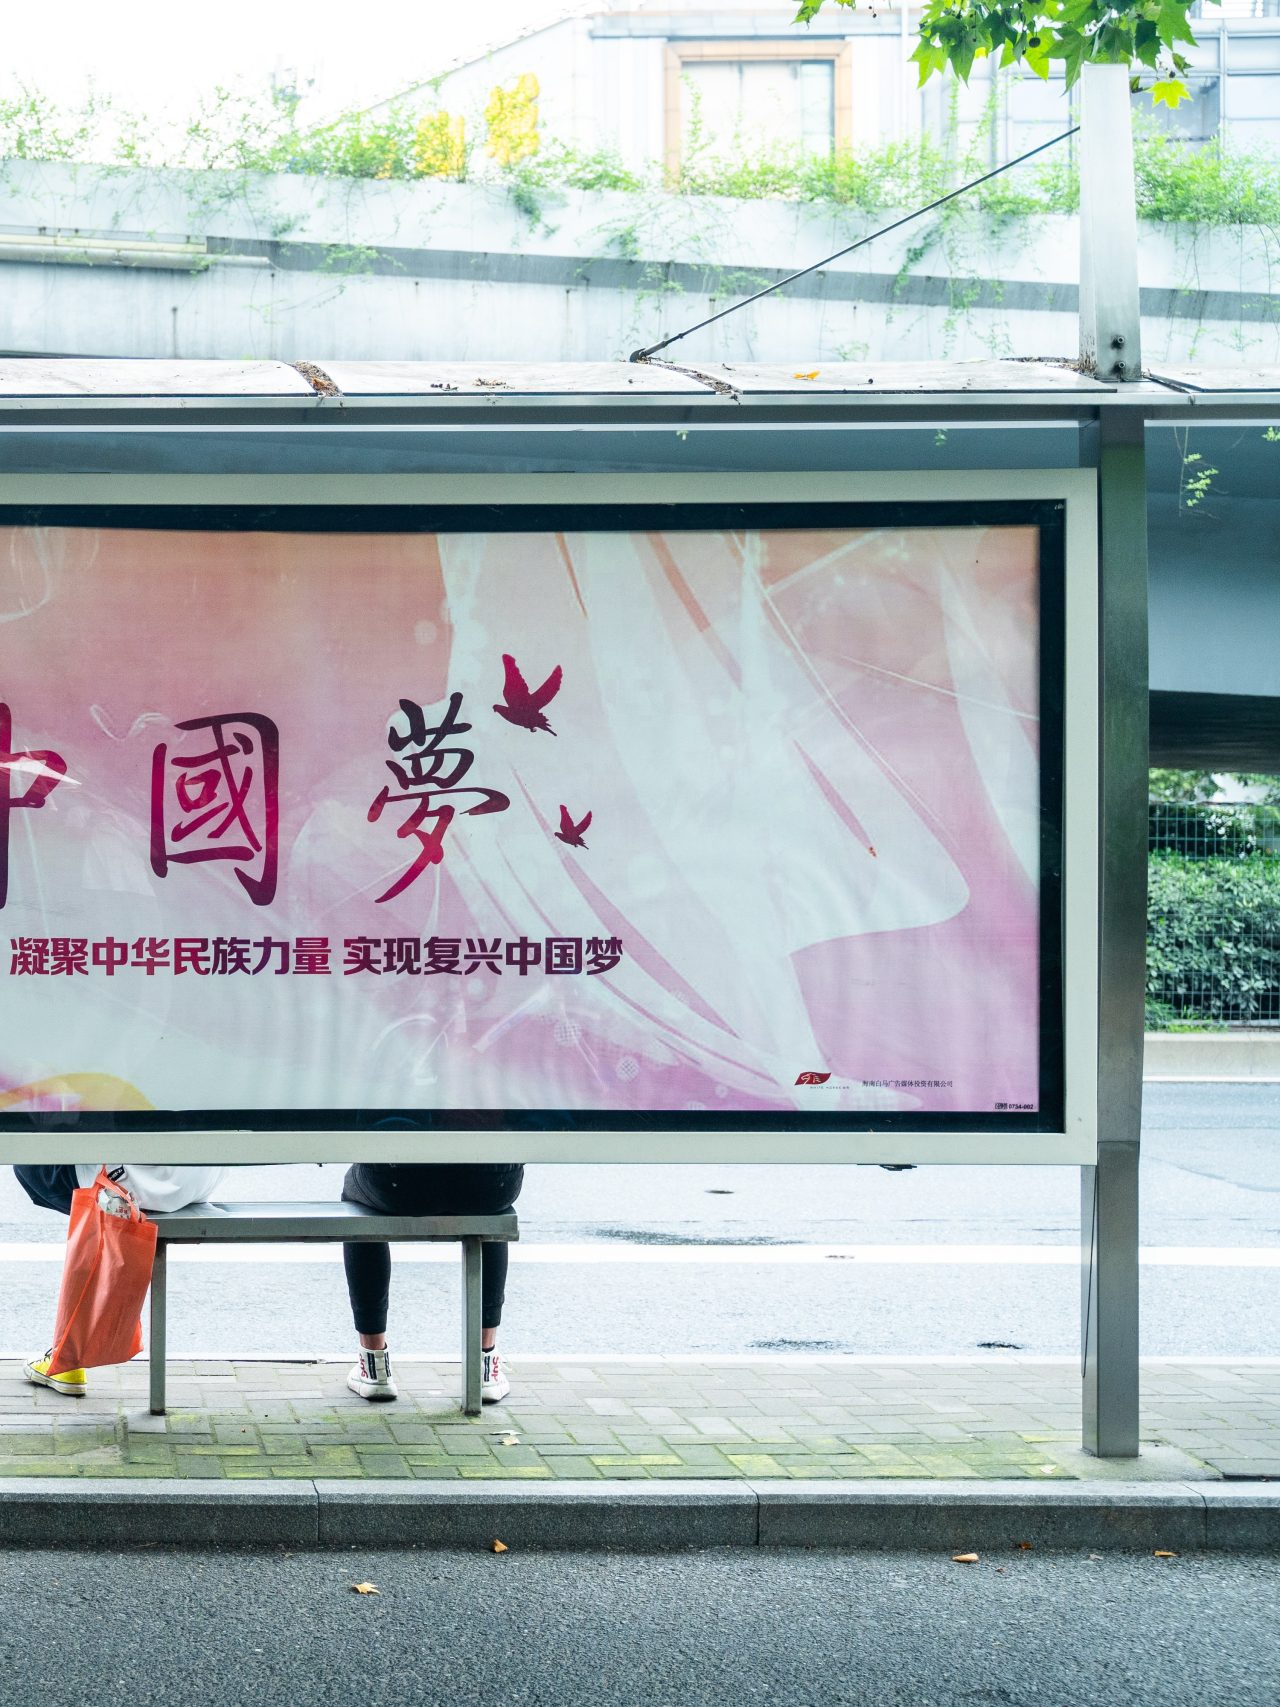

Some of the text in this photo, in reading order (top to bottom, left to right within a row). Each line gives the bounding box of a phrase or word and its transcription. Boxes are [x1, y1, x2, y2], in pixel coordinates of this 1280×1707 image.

[9, 936, 624, 977] 凝聚中华民族力量 实现复兴中国梦
